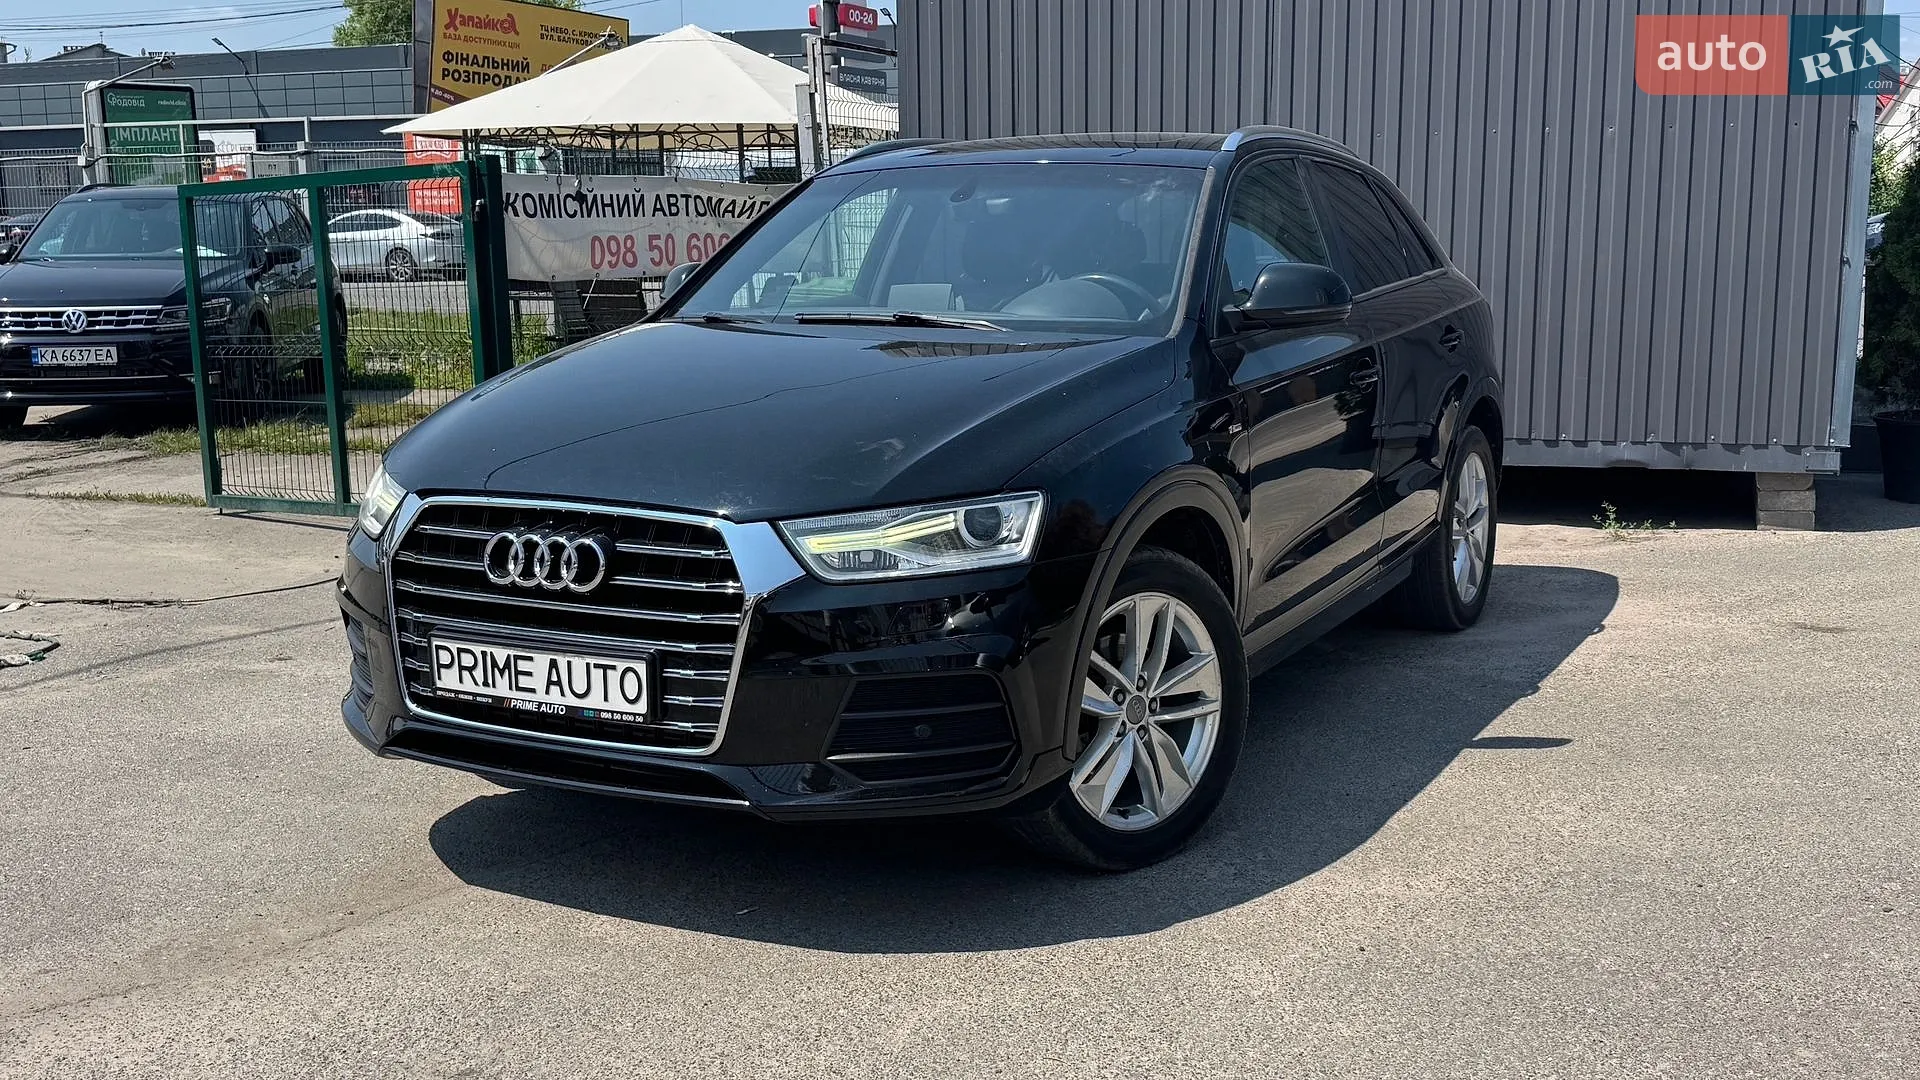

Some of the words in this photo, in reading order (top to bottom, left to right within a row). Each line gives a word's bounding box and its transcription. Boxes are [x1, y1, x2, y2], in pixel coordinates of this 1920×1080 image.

[849, 9, 873, 25] 00-24
[540, 24, 550, 33] ТЦ
[443, 32, 462, 41] БАЗА
[462, 35, 507, 47] ДОСТУПНИХ
[540, 33, 556, 41] ВУЛ.
[442, 50, 530, 74] ФІНАЛЬНИЙ
[503, 188, 646, 219] КОМІСІЙНИЙ
[590, 234, 638, 270] 098
[648, 233, 676, 267] 50
[40, 349, 58, 362] KA
[62, 349, 91, 362] 6637
[95, 348, 114, 362] EA
[434, 644, 537, 694] PRIME
[545, 658, 643, 704] AUTO
[539, 701, 566, 715] AUTO
